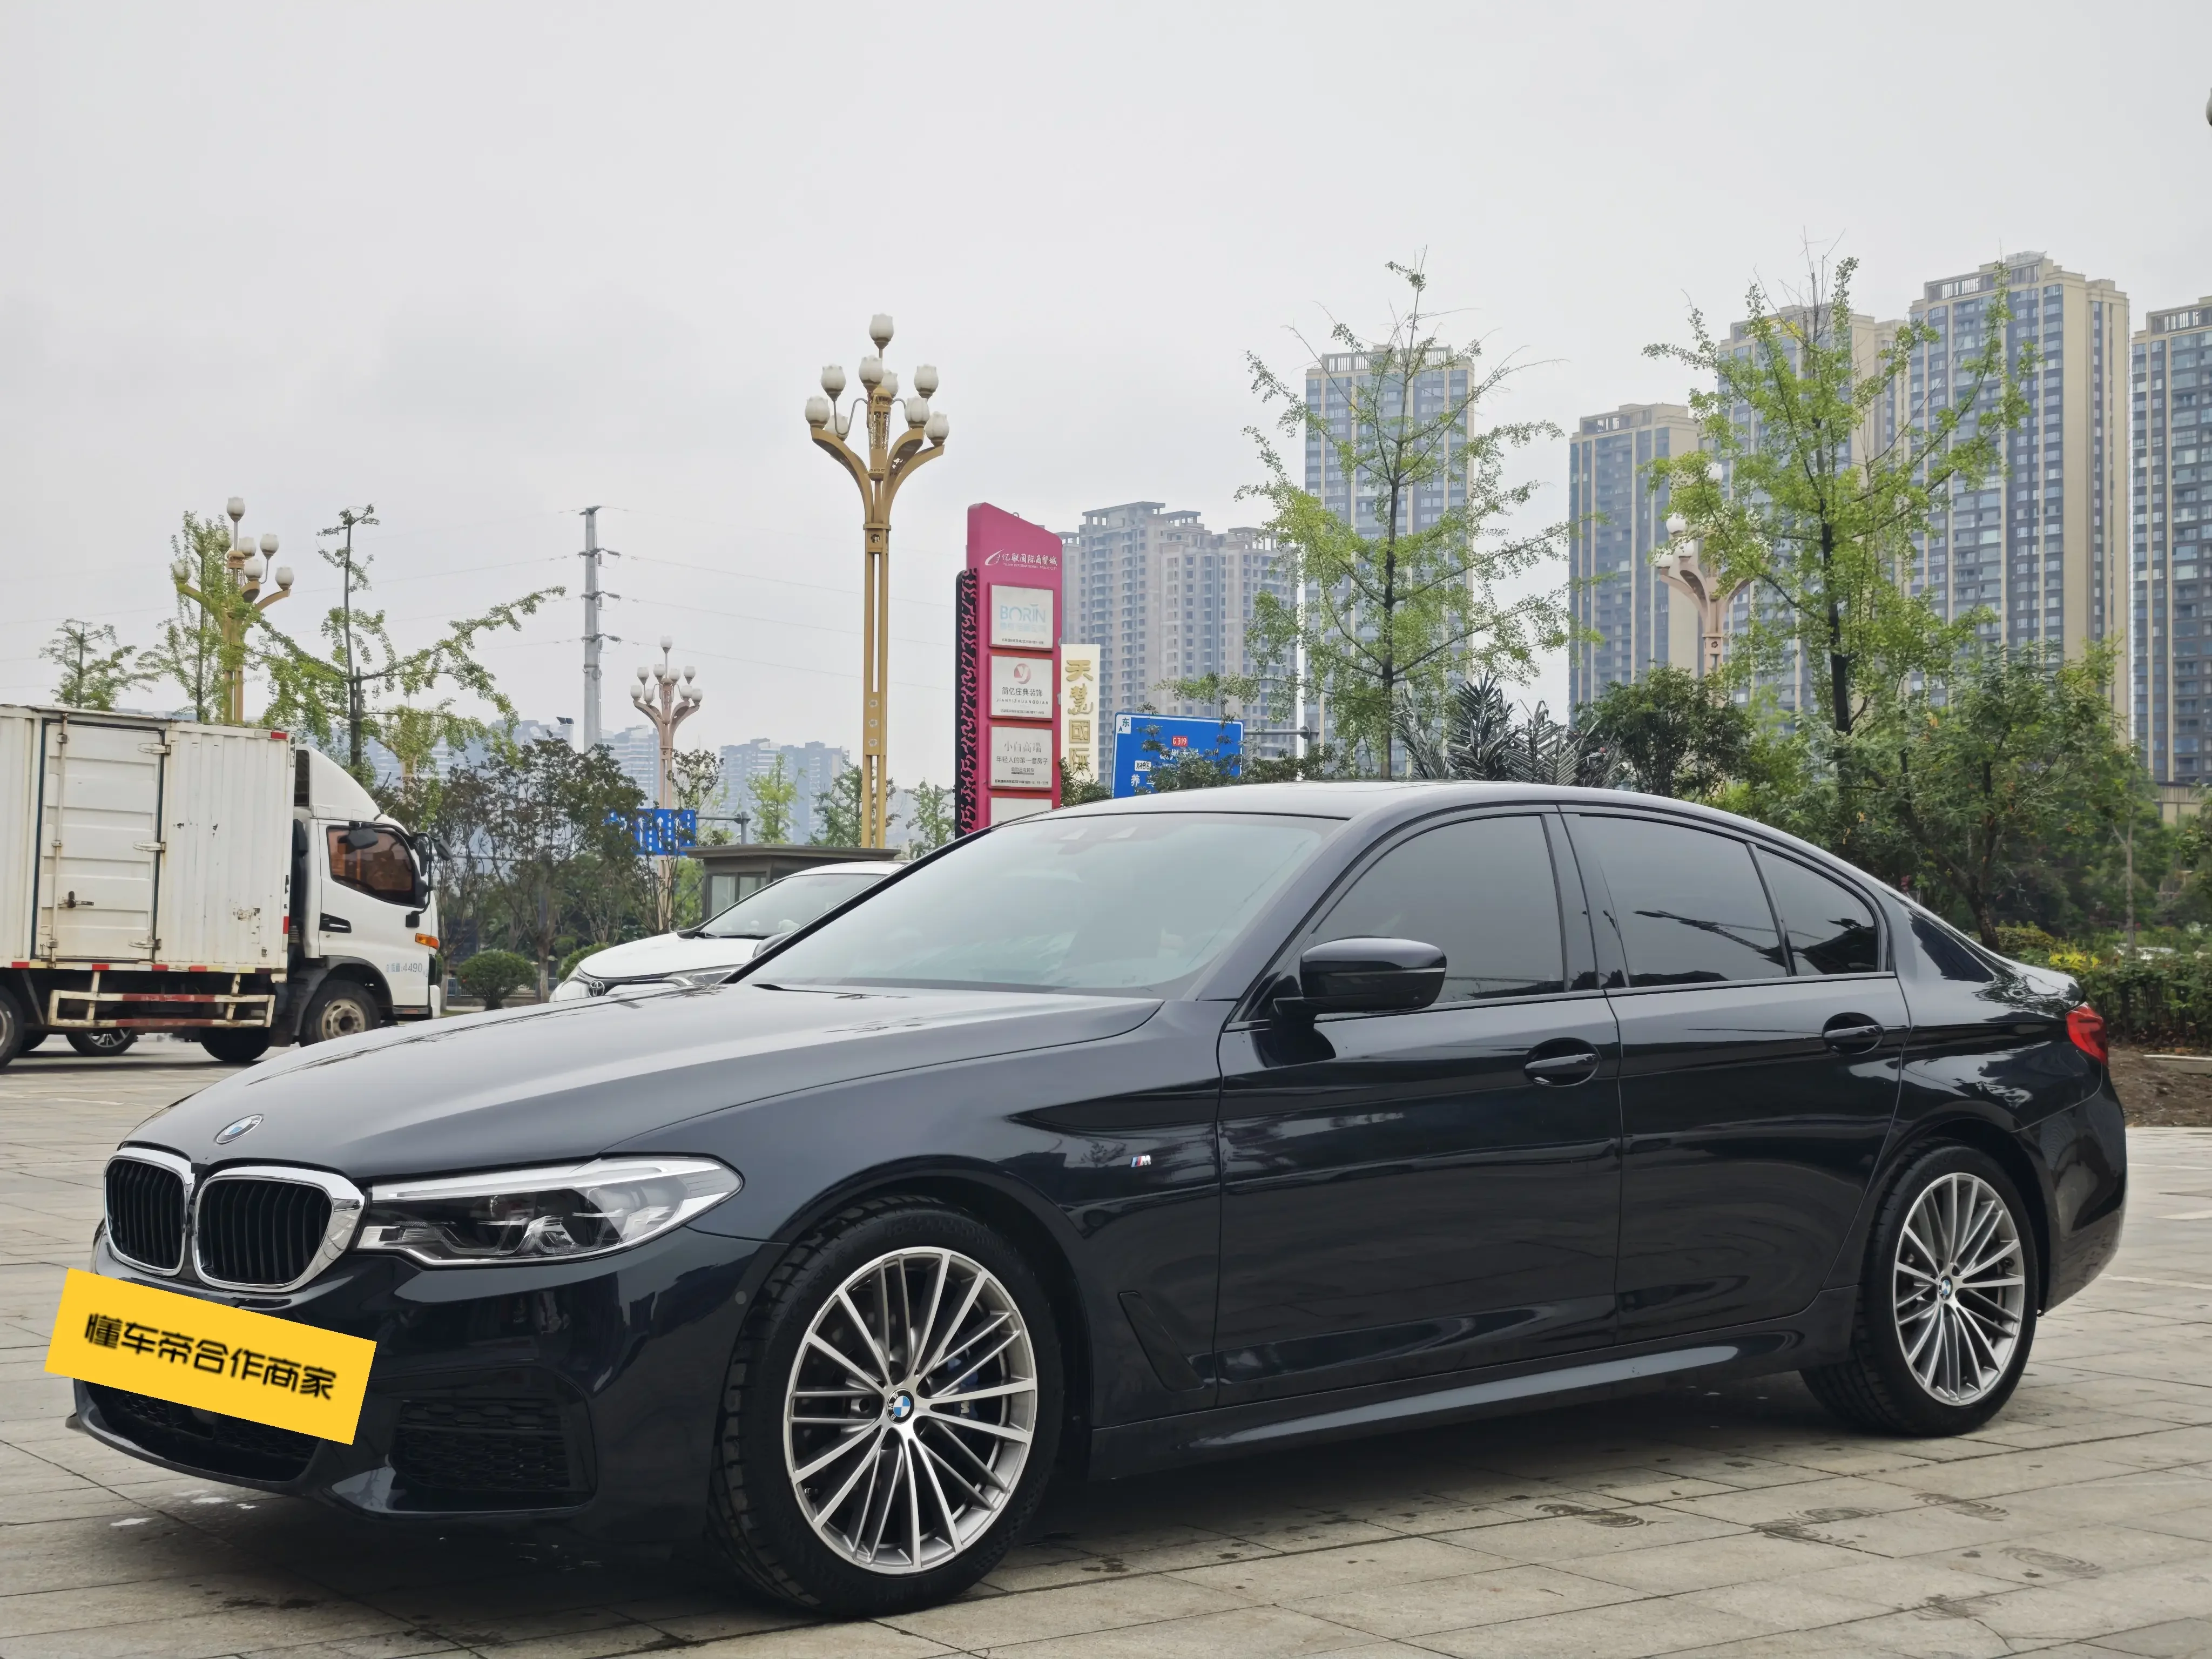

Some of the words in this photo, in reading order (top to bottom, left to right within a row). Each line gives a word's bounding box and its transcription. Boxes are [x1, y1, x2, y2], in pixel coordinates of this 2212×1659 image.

[1002, 686, 1043, 697] 简亿庄典装饰
[1122, 717, 1130, 727] 东
[1172, 737, 1186, 745] G319
[996, 756, 1048, 765] 年轻人的第一套房子
[888, 1390, 899, 1420] BMW
